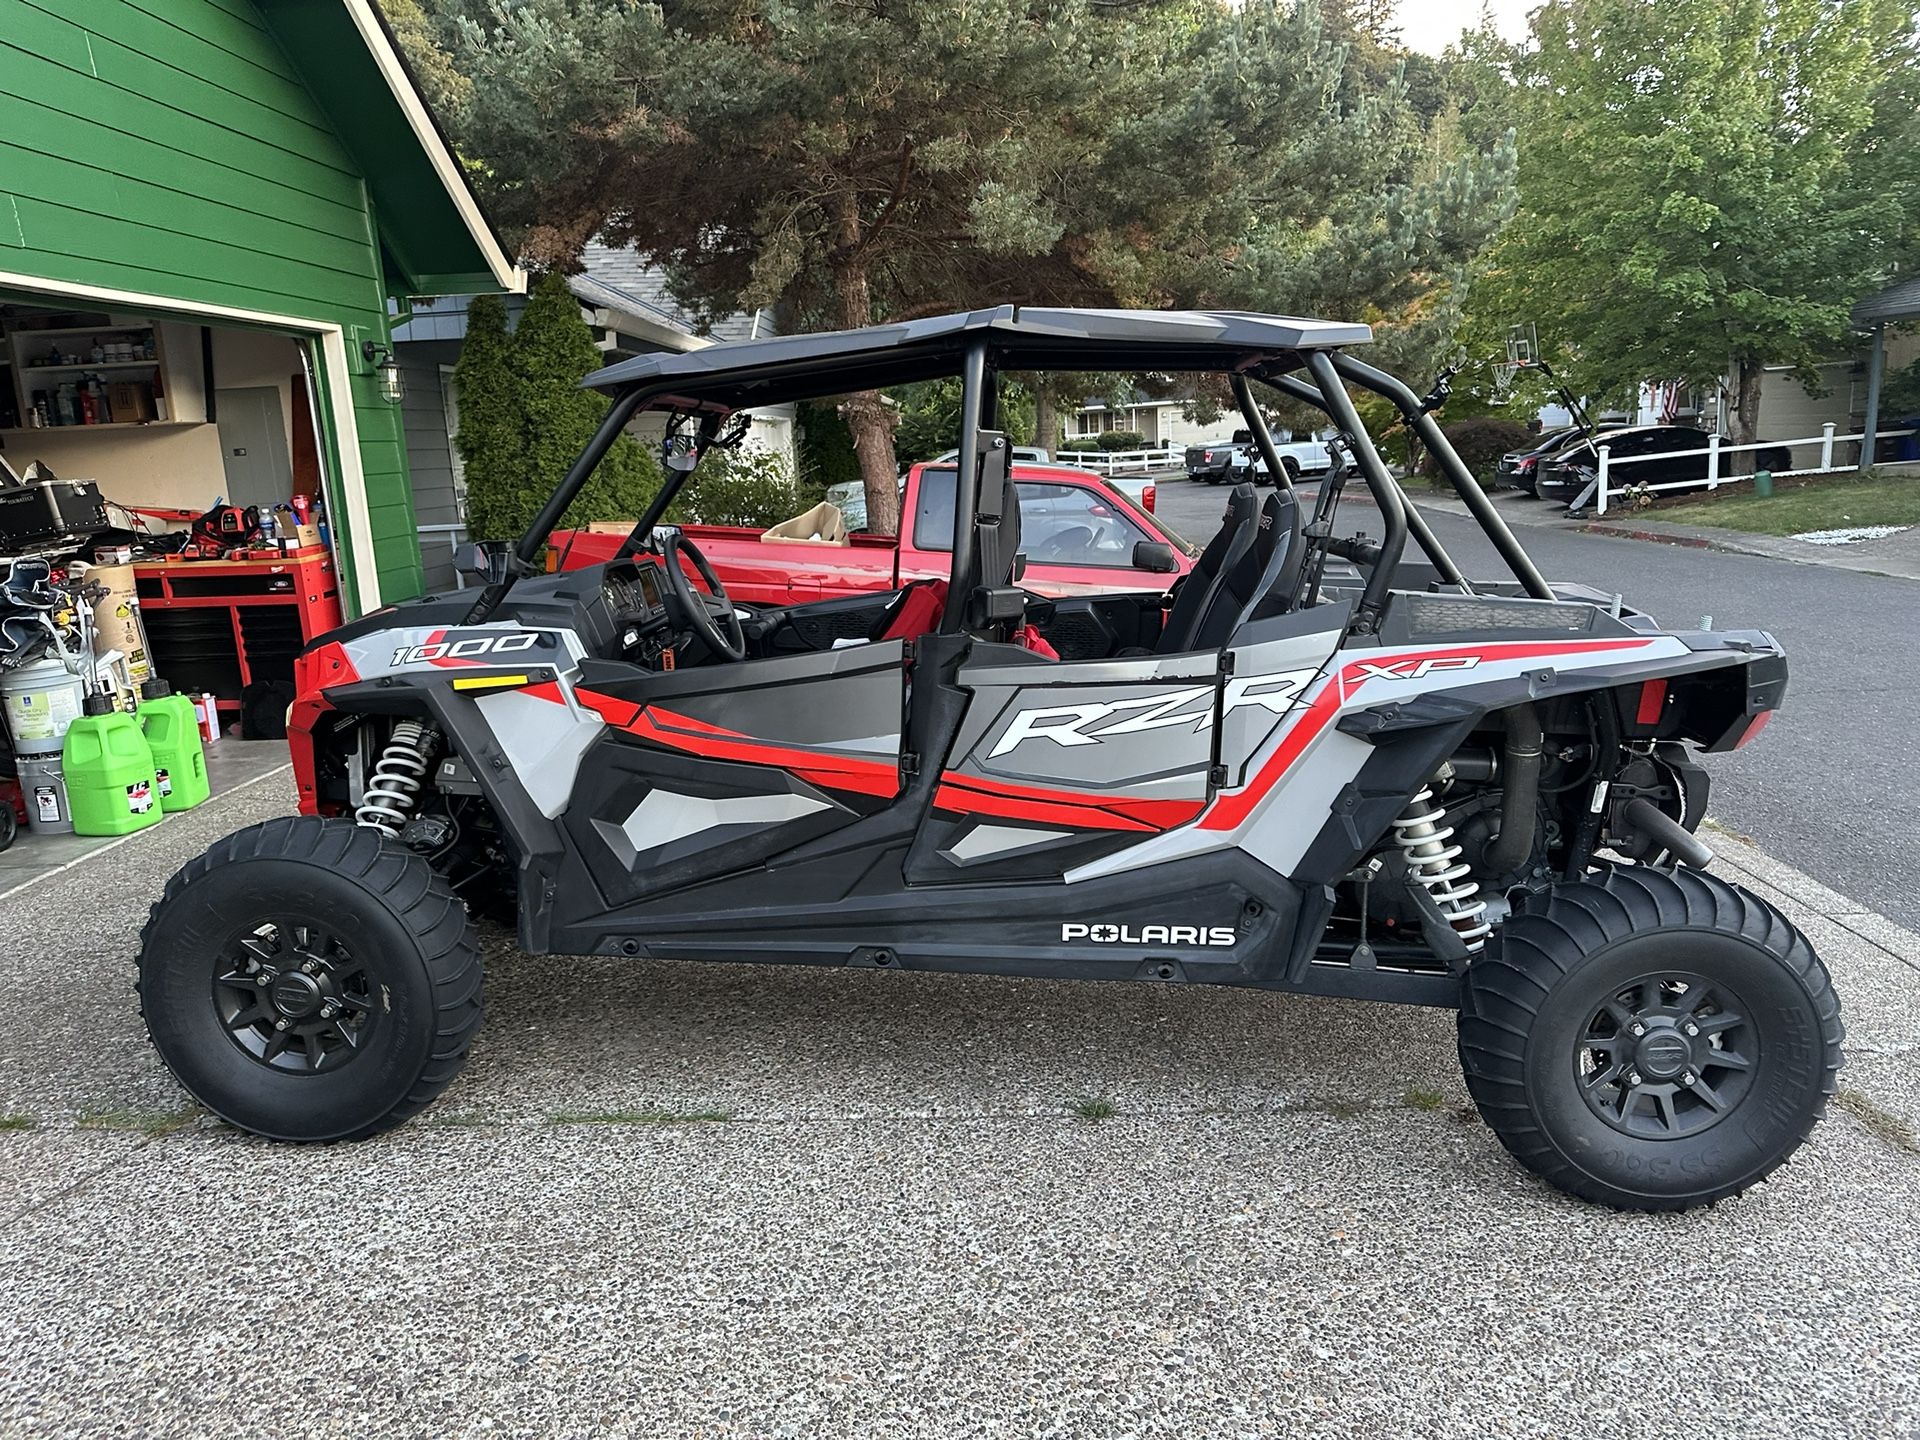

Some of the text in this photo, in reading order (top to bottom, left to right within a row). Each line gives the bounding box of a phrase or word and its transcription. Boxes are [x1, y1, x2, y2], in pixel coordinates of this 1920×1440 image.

[389, 632, 539, 667] 1000
[1337, 656, 1483, 681] XP
[985, 667, 1329, 760] RZR
[1061, 923, 1237, 947] POLARIS
